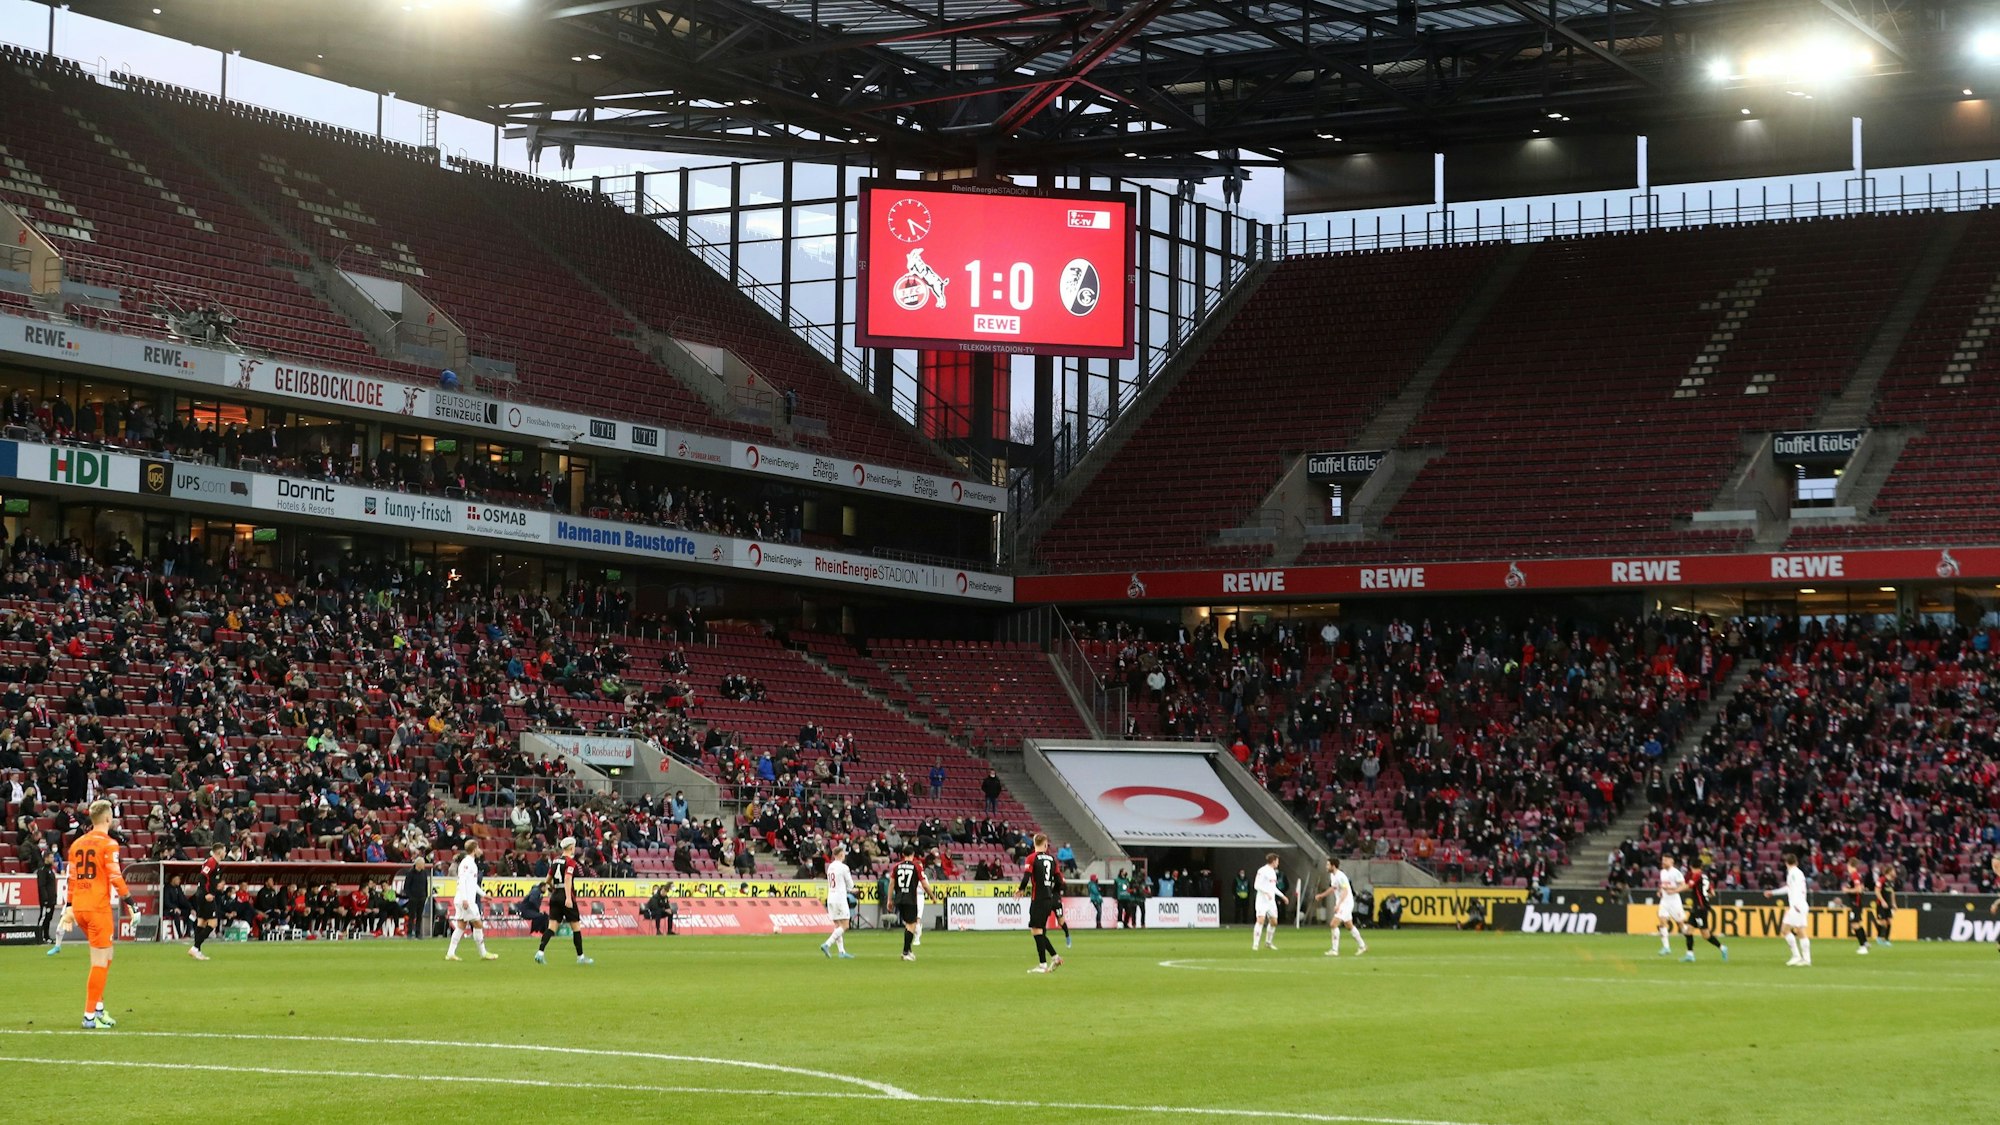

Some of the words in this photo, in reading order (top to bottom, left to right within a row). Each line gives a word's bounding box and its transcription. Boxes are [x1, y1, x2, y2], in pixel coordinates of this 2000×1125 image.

[952, 184, 1028, 196] RheinEnergieSTADION
[965, 259, 1034, 311] 1:0
[977, 317, 1017, 331] REWE
[25, 325, 66, 349] REWE
[143, 345, 182, 368] REWE
[959, 343, 991, 352] TELEKOM
[992, 345, 1035, 353] STADION-TV
[435, 393, 482, 411] DEUTSCHE
[435, 405, 482, 423] STEINZEUG
[592, 420, 615, 439] UTH
[634, 427, 656, 446] UTH
[1774, 435, 1817, 454] Gaffel
[50, 447, 109, 488] HDI
[760, 454, 799, 471] RheinEnergie
[815, 458, 835, 471] Rhein
[1309, 456, 1346, 474] Gaffel
[813, 466, 839, 482] Energie
[866, 473, 902, 488] RheinEnergie
[916, 475, 935, 487] Rhein
[177, 474, 226, 494] UPS.com
[278, 479, 335, 502] Dorint
[914, 483, 939, 498] Energie
[963, 489, 997, 503] RheinEnergie
[277, 500, 299, 511] Hotels
[301, 504, 306, 512] &
[308, 504, 335, 516] Resorts
[385, 497, 452, 523] funny-frisch
[483, 508, 526, 526] OSMAB
[558, 520, 621, 546] Hamann
[625, 530, 696, 556] Baustoffe
[763, 552, 802, 567] RheinEnergie
[1771, 555, 1844, 578] REWE
[815, 556, 919, 586] RheinEnergieSTADION
[1360, 567, 1425, 589] REWE
[1611, 560, 1682, 583] REWE
[968, 580, 1002, 594] RheinEnergie
[1223, 571, 1285, 592] REWE
[592, 746, 625, 758] Rosbacher
[1124, 829, 1257, 839] RheinEnergie
[75, 849, 97, 880] 26
[554, 864, 563, 883] 4
[1043, 859, 1052, 881] 3
[827, 872, 836, 889] 18
[897, 869, 914, 888] 27
[497, 882, 525, 897] Köln
[600, 883, 625, 897] Köln
[784, 884, 807, 897] Köln
[946, 885, 966, 898] Köln
[994, 886, 1014, 897] Radi
[1521, 903, 1598, 933] bwin
